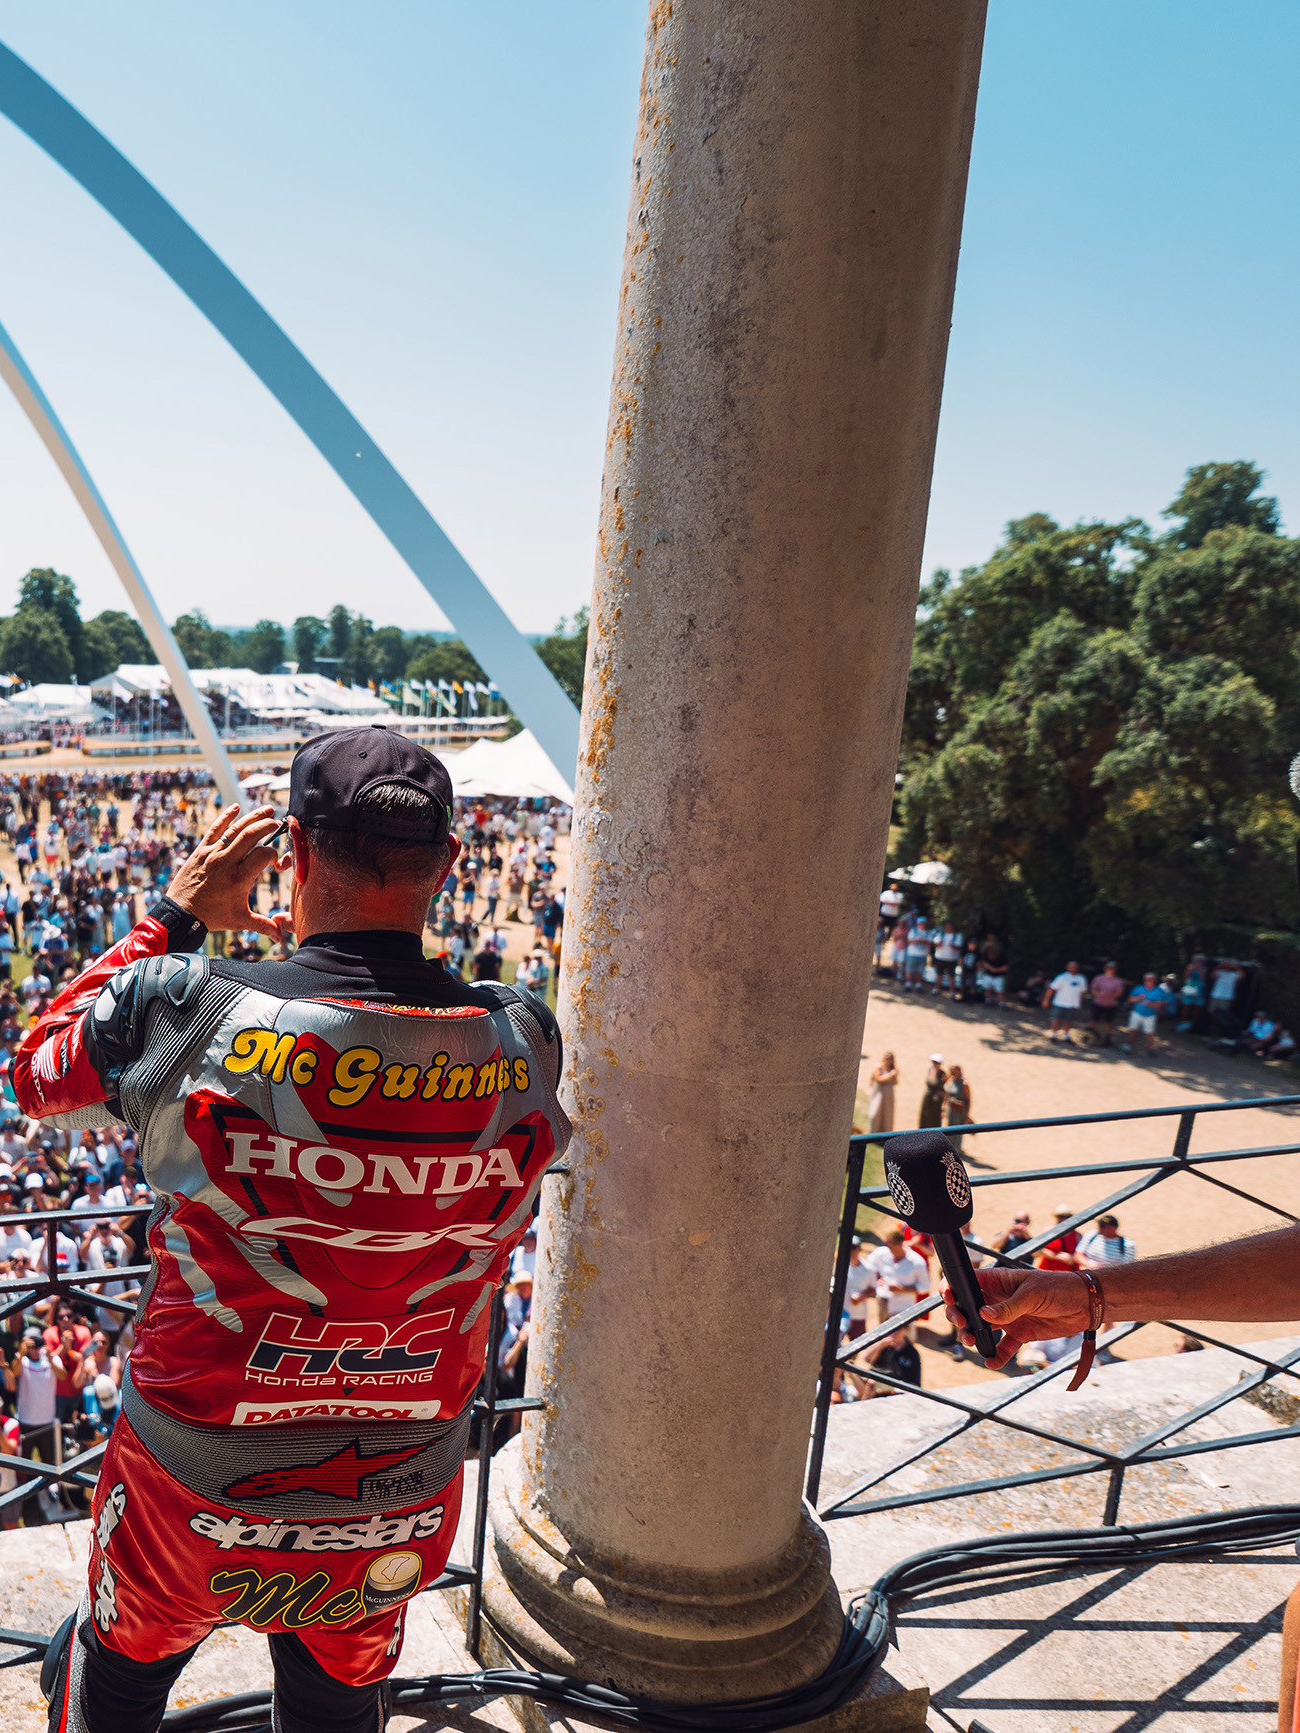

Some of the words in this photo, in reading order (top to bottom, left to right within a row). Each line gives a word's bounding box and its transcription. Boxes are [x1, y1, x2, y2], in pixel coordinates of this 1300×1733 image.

[223, 1028, 319, 1087] Mc
[225, 1131, 524, 1195] HONDA
[239, 1216, 498, 1252] CBR
[246, 1308, 455, 1374] HRC
[245, 1370, 337, 1387] Honda
[342, 1371, 434, 1386] RACING
[243, 1404, 418, 1426] DATATOOL
[189, 1505, 445, 1551] alpinestars
[211, 1567, 363, 1628] Mc
